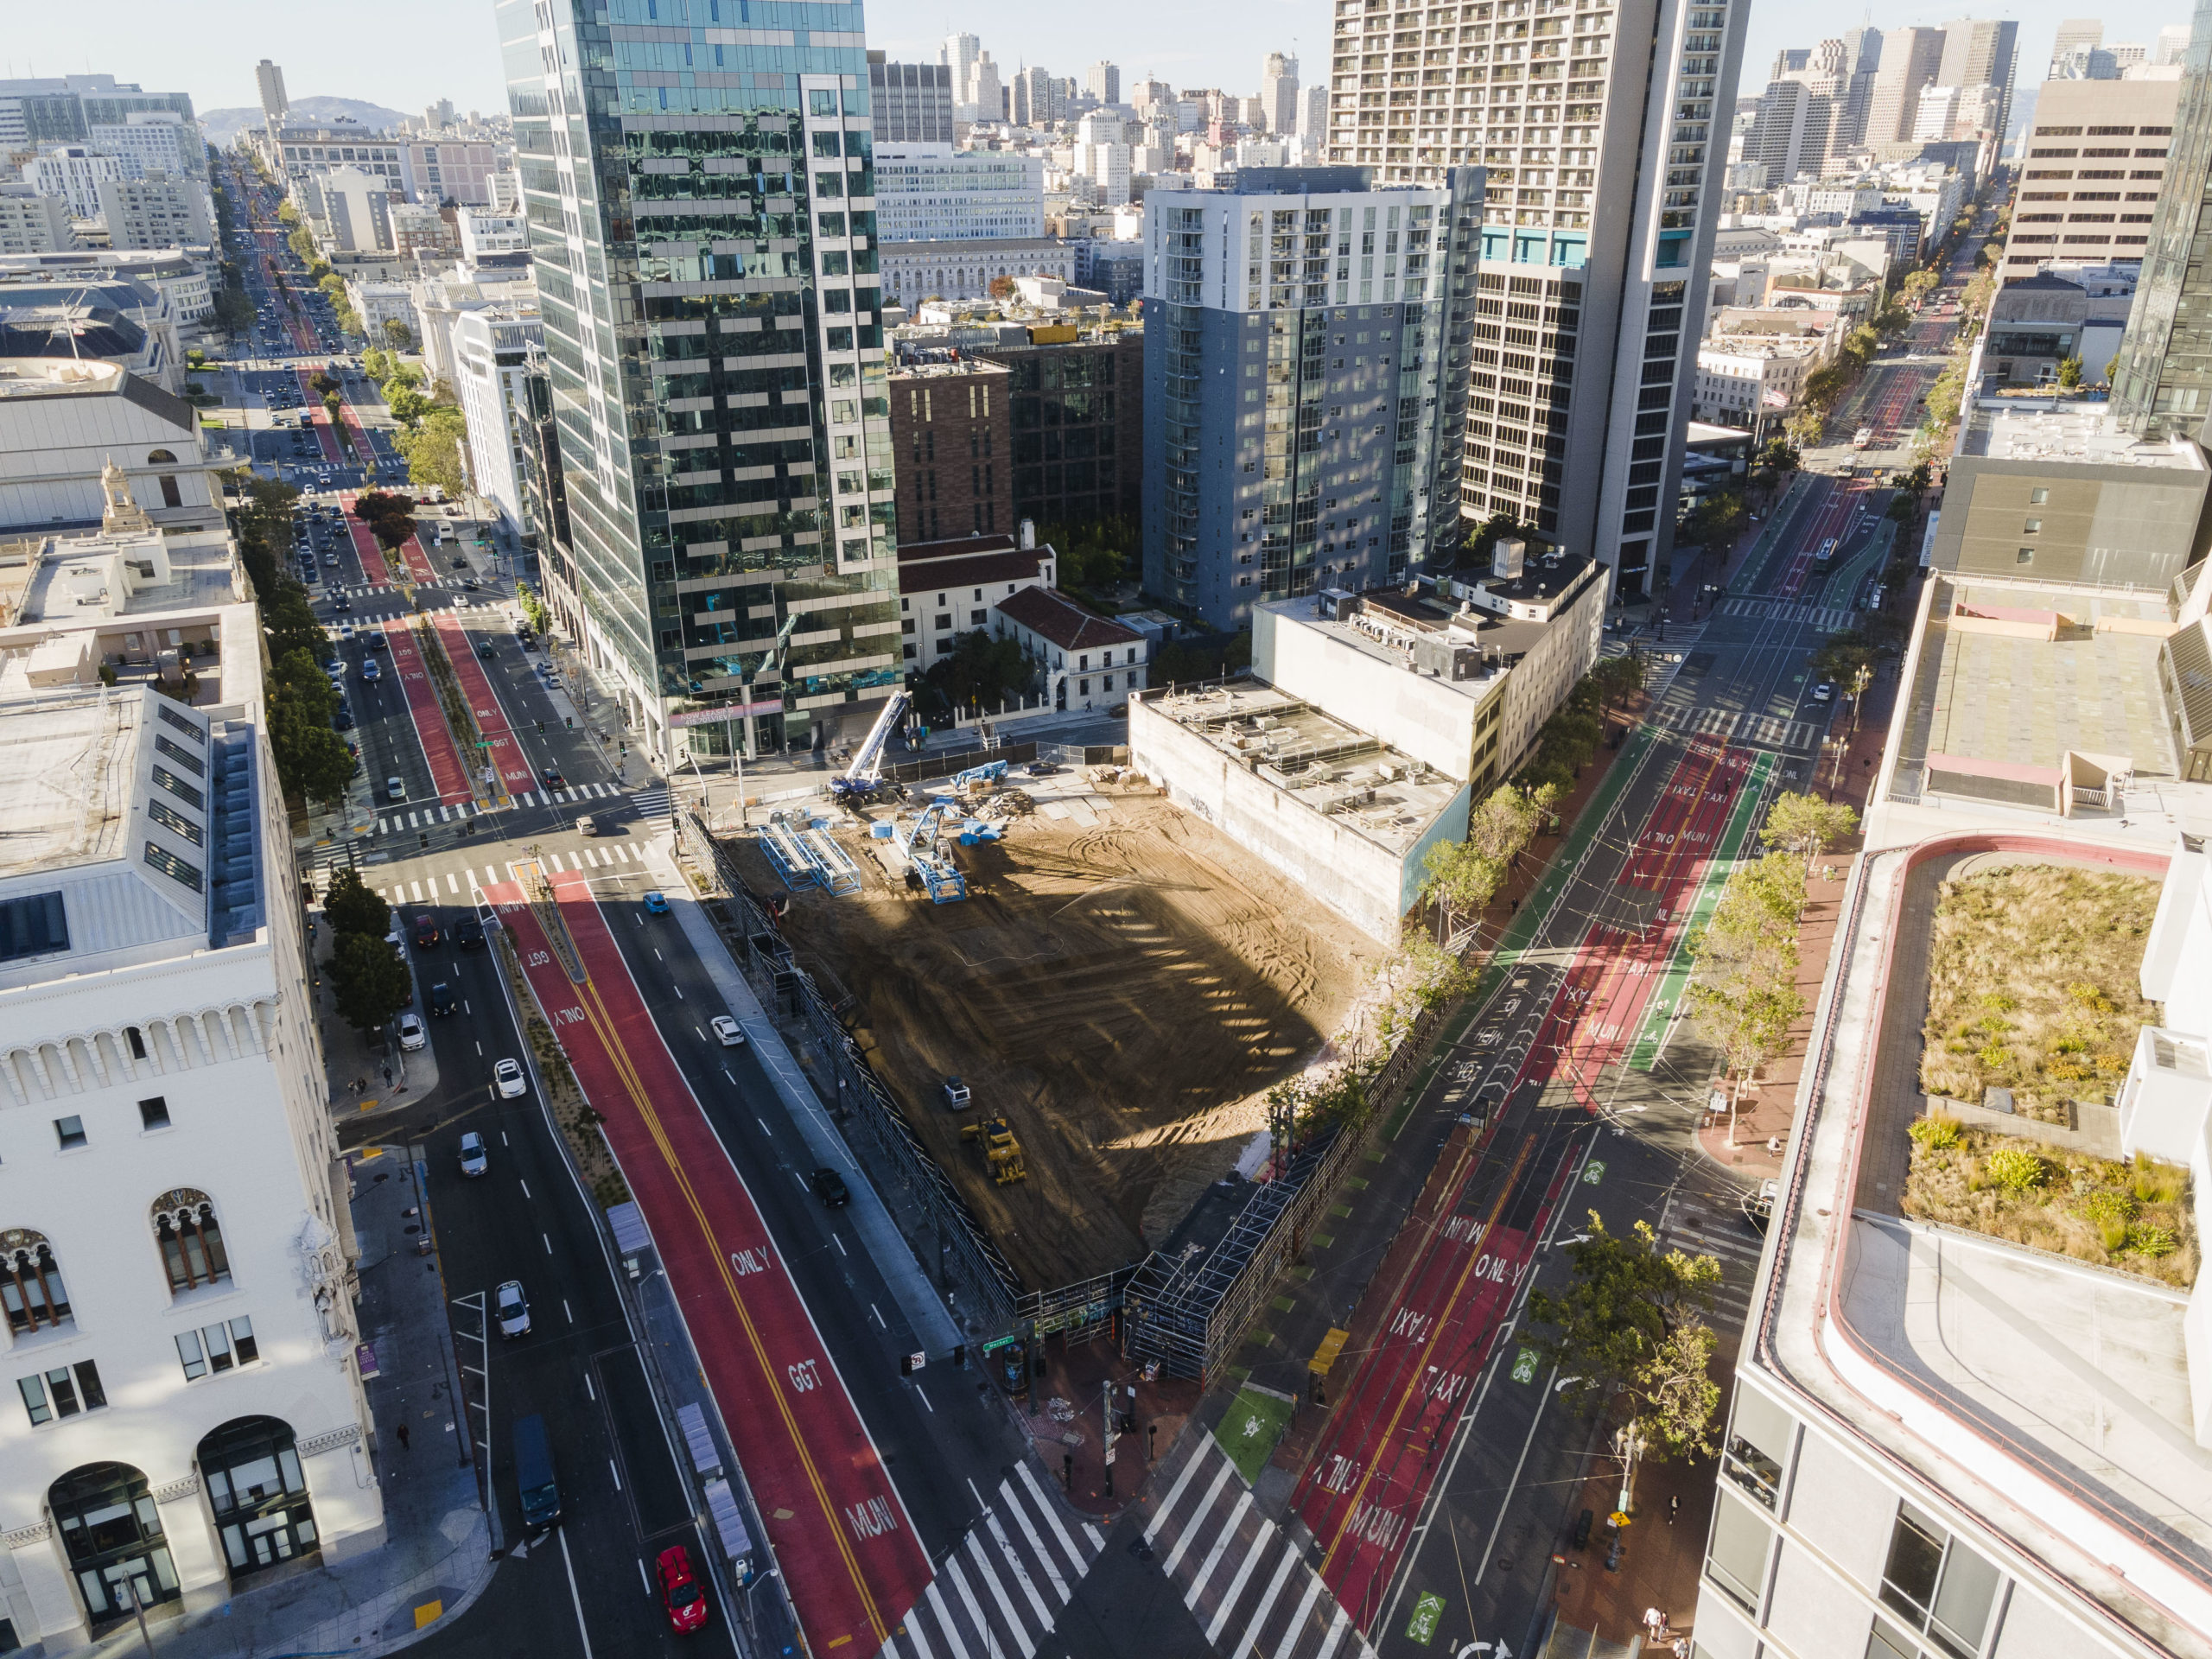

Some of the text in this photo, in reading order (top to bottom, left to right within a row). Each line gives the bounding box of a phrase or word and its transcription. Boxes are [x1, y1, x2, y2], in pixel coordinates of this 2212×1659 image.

[1920, 533, 1936, 567] @twitter
[477, 708, 499, 718] ONLY
[680, 707, 734, 721] NOW LEASING
[493, 738, 509, 747] GGT
[505, 770, 528, 780] MUNI
[1674, 785, 1698, 797] TAXI
[1703, 791, 1728, 804] TAXI
[1643, 830, 1675, 844] ONLY
[1681, 830, 1711, 844] MUNI
[498, 899, 525, 915] MUNI
[528, 950, 550, 967] GGT
[553, 1006, 585, 1027] ONLY
[1586, 1020, 1624, 1041] MUNI
[731, 1245, 771, 1276] ONLY
[1475, 1254, 1527, 1287] ONLY
[1389, 1306, 1433, 1344] TAXI
[988, 1339, 1008, 1349] Market
[788, 1358, 823, 1393] GGT
[1421, 1365, 1467, 1403] TAXI
[844, 1494, 898, 1541] MUNI
[1345, 1500, 1406, 1552] MUNI
